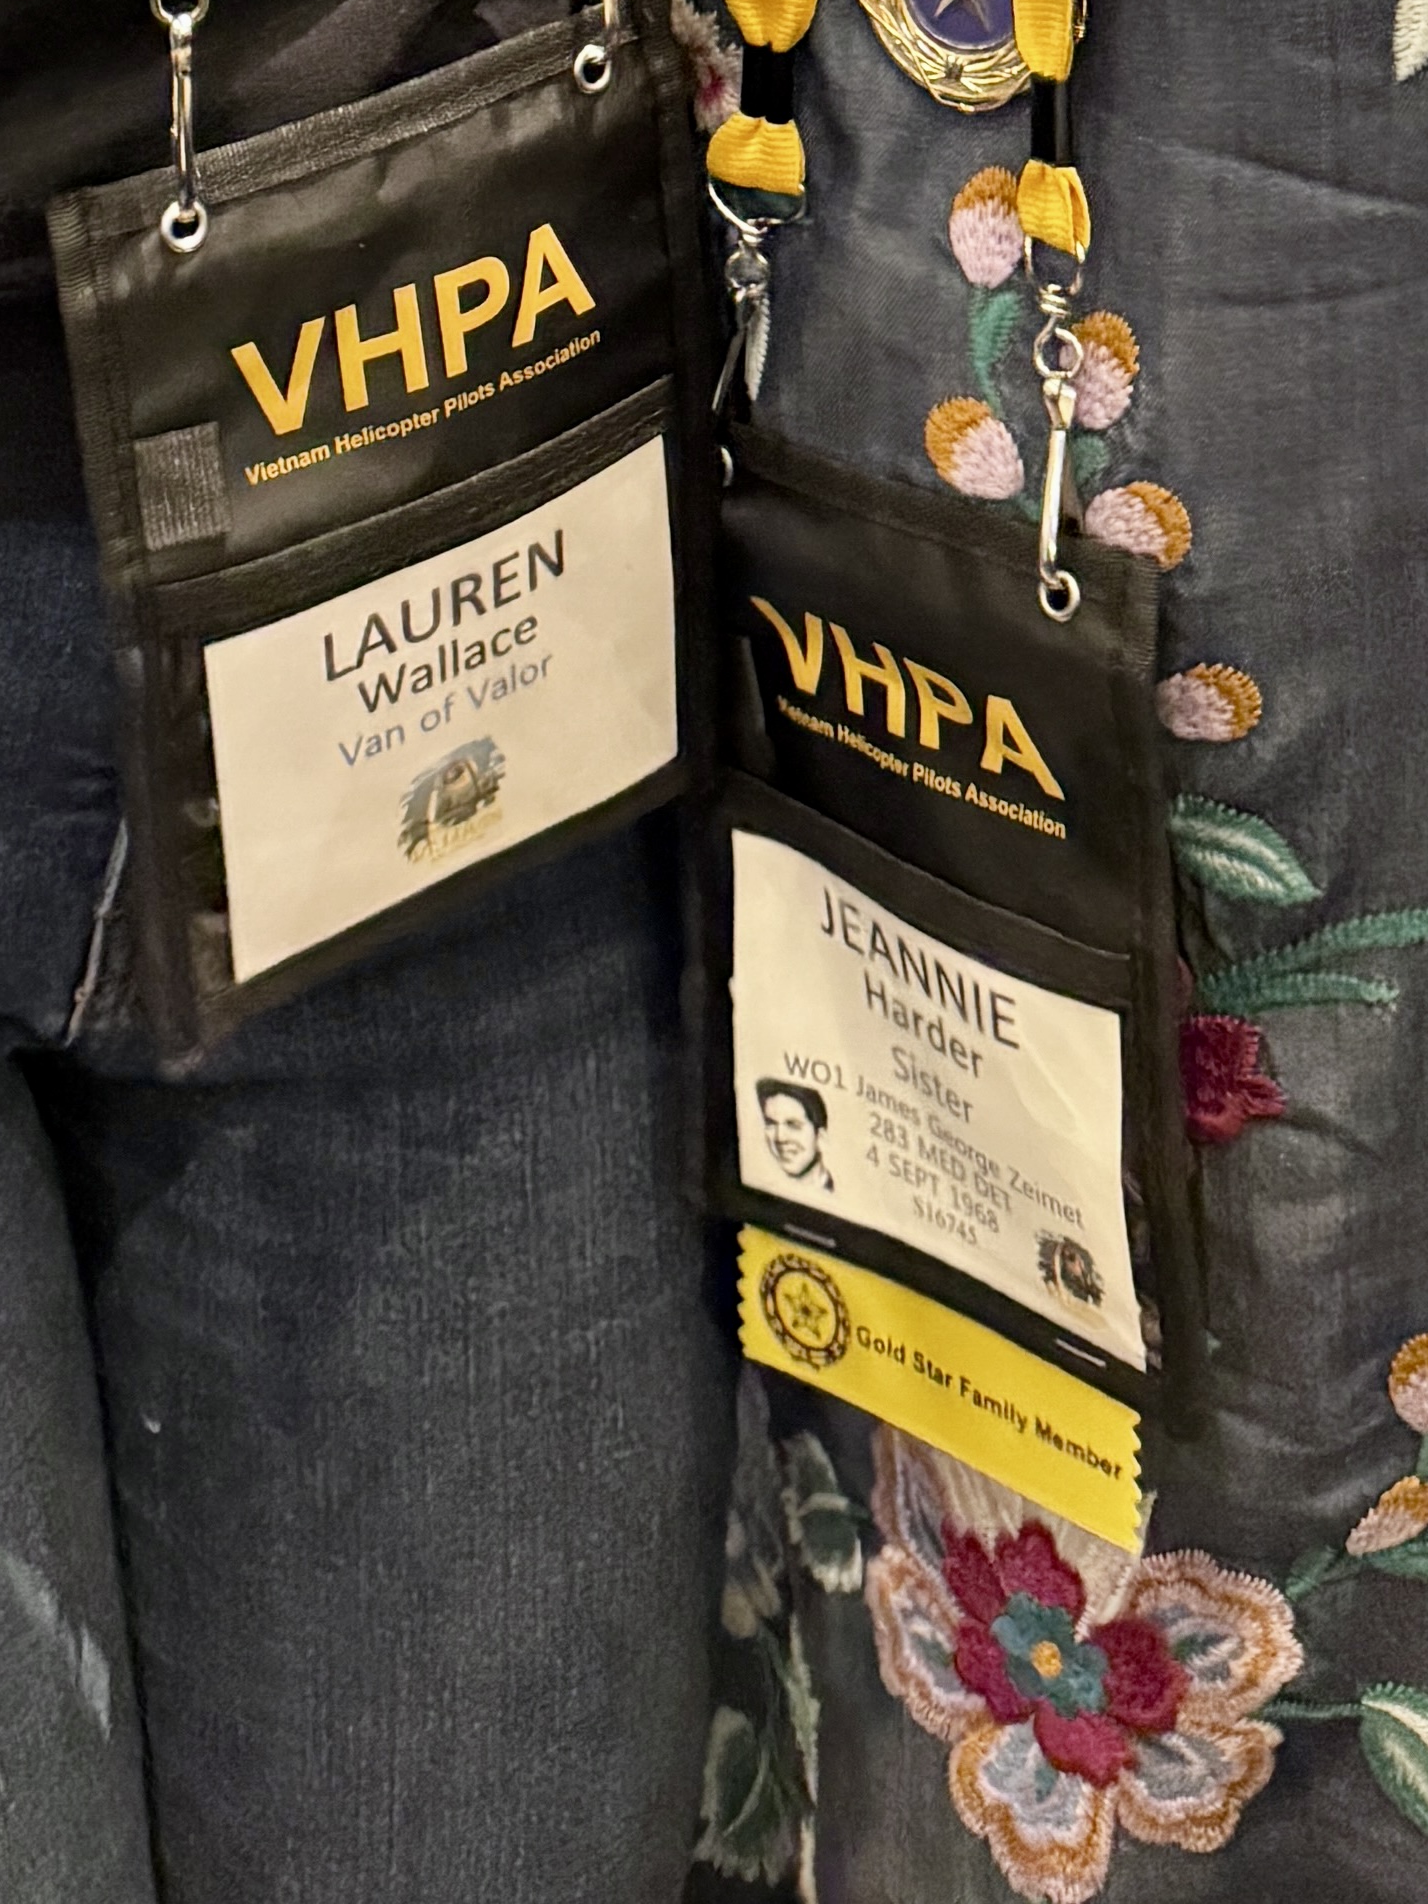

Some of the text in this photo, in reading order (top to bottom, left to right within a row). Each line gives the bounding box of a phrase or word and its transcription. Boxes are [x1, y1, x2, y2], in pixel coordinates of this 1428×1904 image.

[231, 223, 596, 435] VHPA
[244, 330, 601, 485] Vietnam Helicopter Pilots Association
[324, 529, 564, 682] LAUREN
[358, 615, 538, 713] Wallace
[338, 654, 553, 767] Van of Valor
[750, 595, 1066, 801] VHPA
[837, 724, 909, 777] Helicopter
[912, 762, 962, 798] Pilots
[965, 782, 1066, 839] Association
[821, 887, 1020, 1050] JEANNIE
[864, 970, 983, 1078] Harder
[784, 1051, 1085, 1230] WO1 James George Zeimet
[891, 1046, 973, 1123] Sister
[866, 1144, 1000, 1234] 4 SEPT 1968
[870, 1111, 1012, 1214] 283 MED DET
[856, 1326, 1123, 1481] Gold Star Family Member
